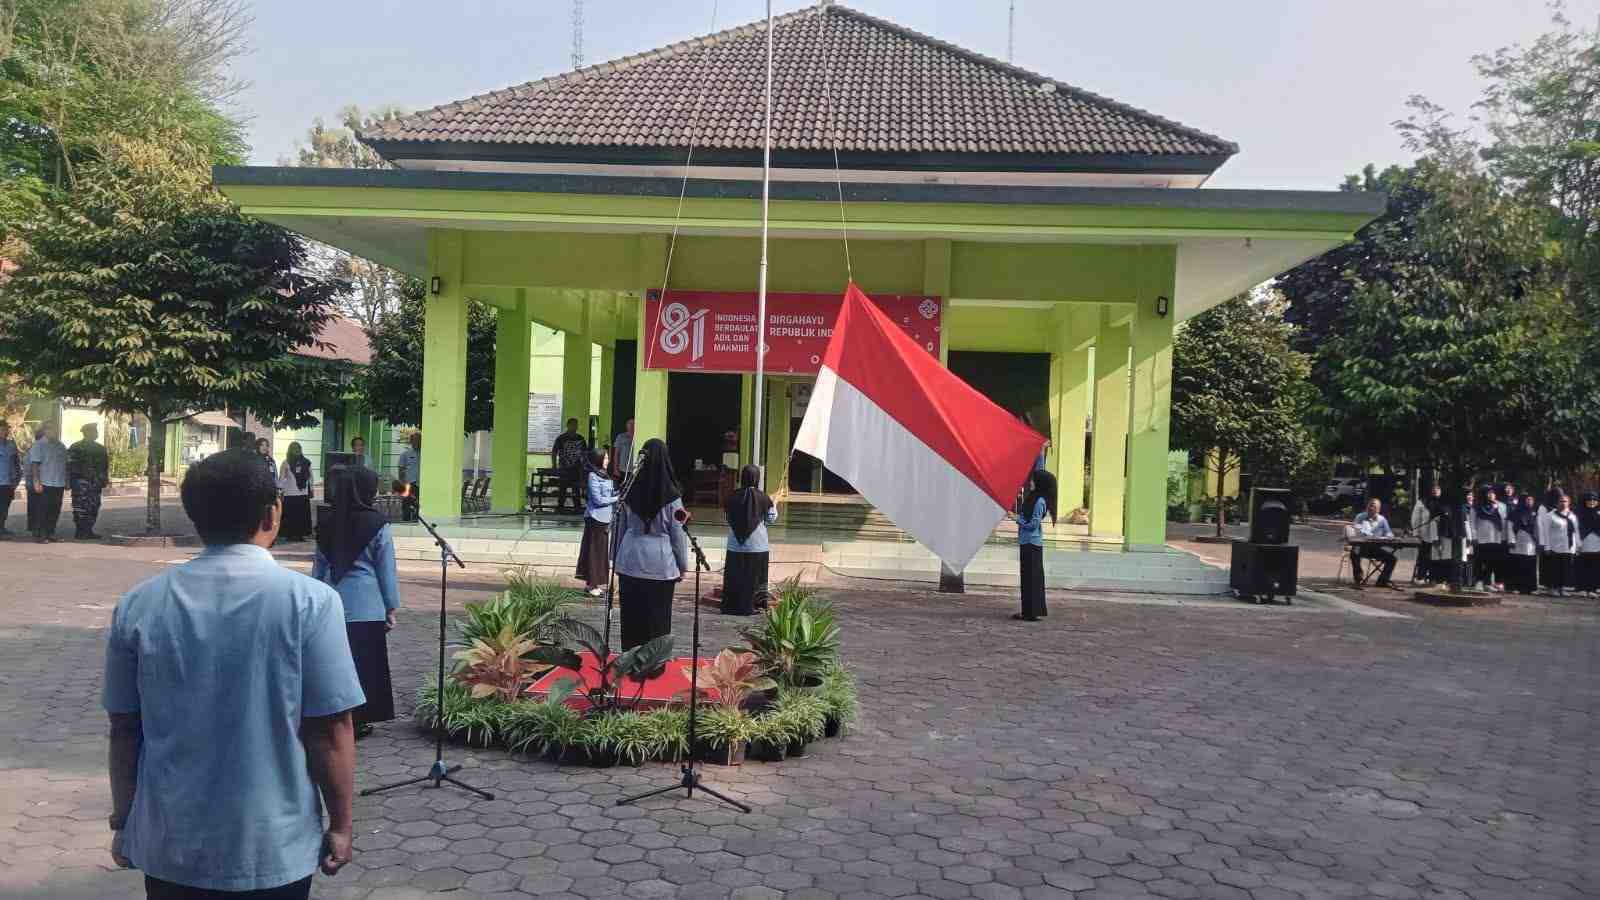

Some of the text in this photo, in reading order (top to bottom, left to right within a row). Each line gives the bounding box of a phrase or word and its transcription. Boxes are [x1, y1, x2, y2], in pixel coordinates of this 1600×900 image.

[769, 315, 824, 325] DIRGAHAYU
[660, 302, 711, 362] 81
[769, 327, 833, 337] REPUBLIK IND
[733, 335, 750, 343] DAN
[713, 343, 749, 353] MAKMUR
